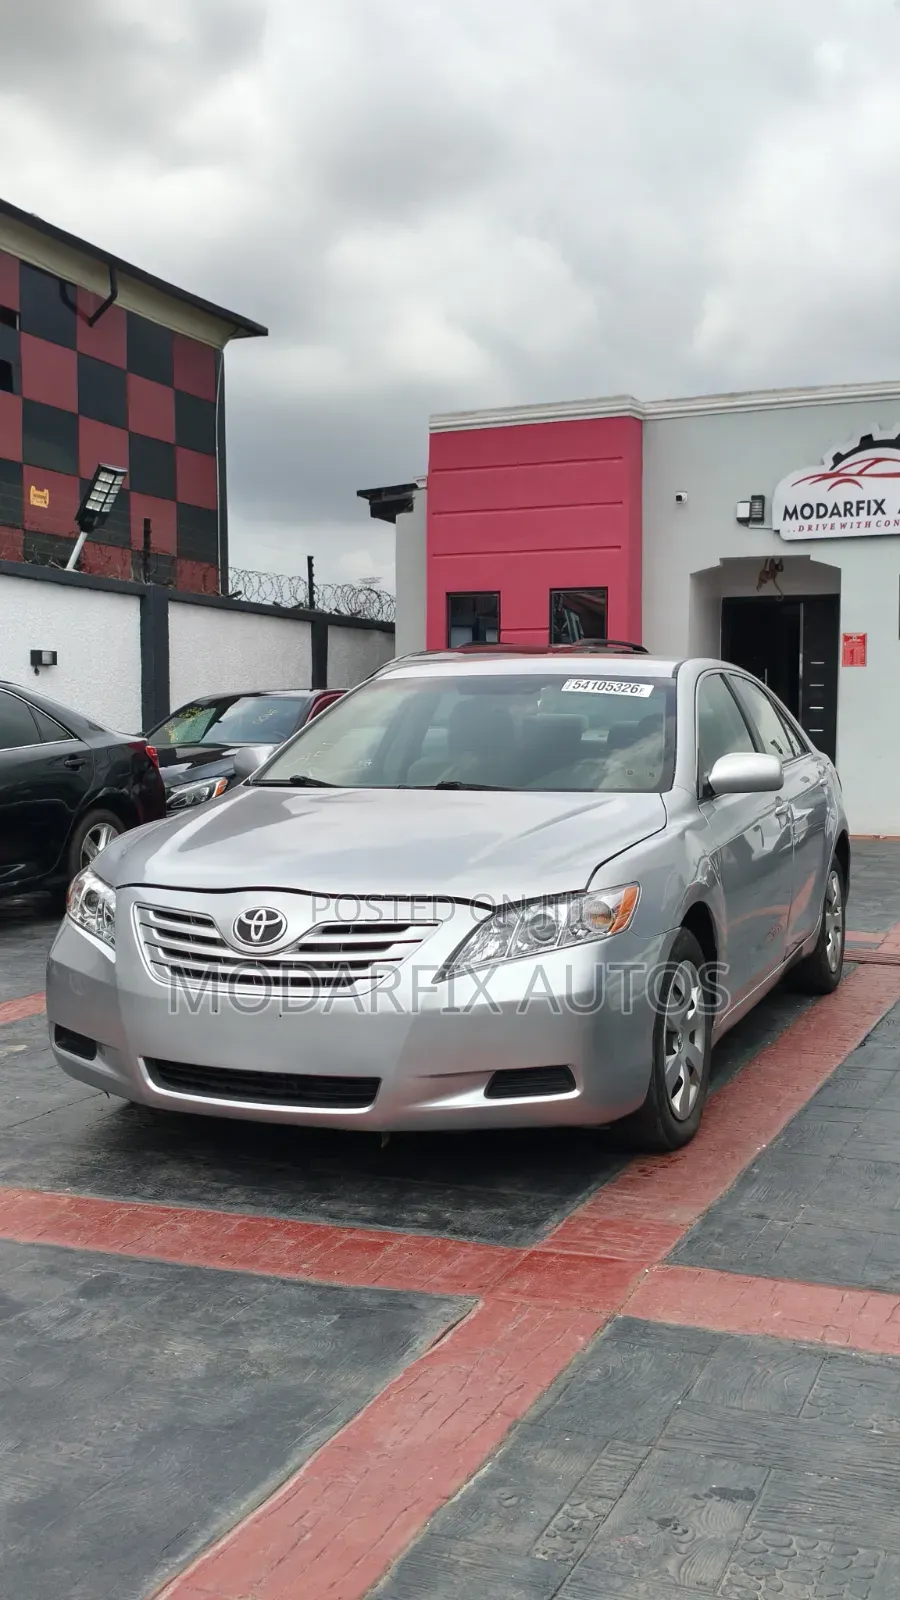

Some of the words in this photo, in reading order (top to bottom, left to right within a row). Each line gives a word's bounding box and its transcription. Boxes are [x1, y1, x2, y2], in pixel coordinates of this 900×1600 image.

[782, 498, 887, 521] MODARFIX
[839, 521, 872, 530] WITH
[875, 519, 900, 528] CON
